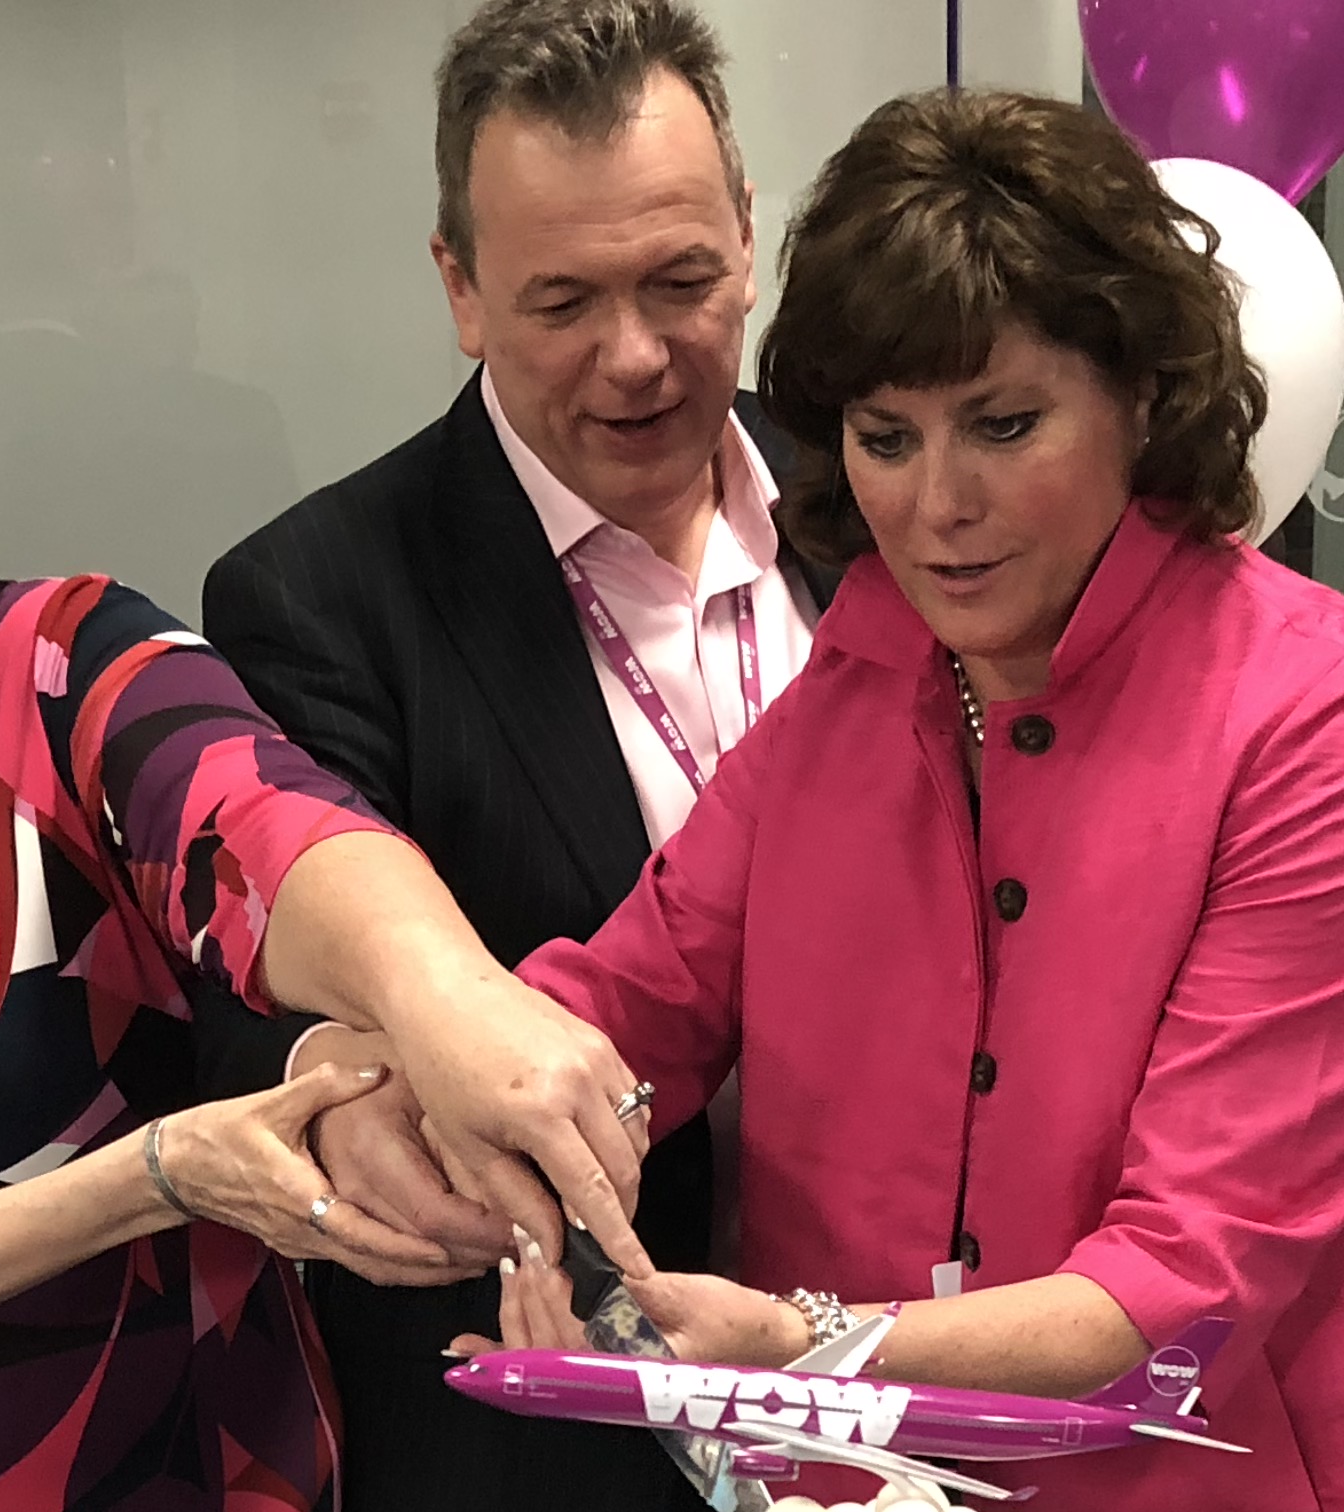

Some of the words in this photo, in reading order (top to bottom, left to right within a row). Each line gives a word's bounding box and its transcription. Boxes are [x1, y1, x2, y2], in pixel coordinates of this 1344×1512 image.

[589, 600, 618, 639] WOW
[625, 655, 653, 695] WOW
[659, 712, 687, 751] WOW
[1151, 1362, 1199, 1379] WOW
[636, 1360, 912, 1447] WOW
